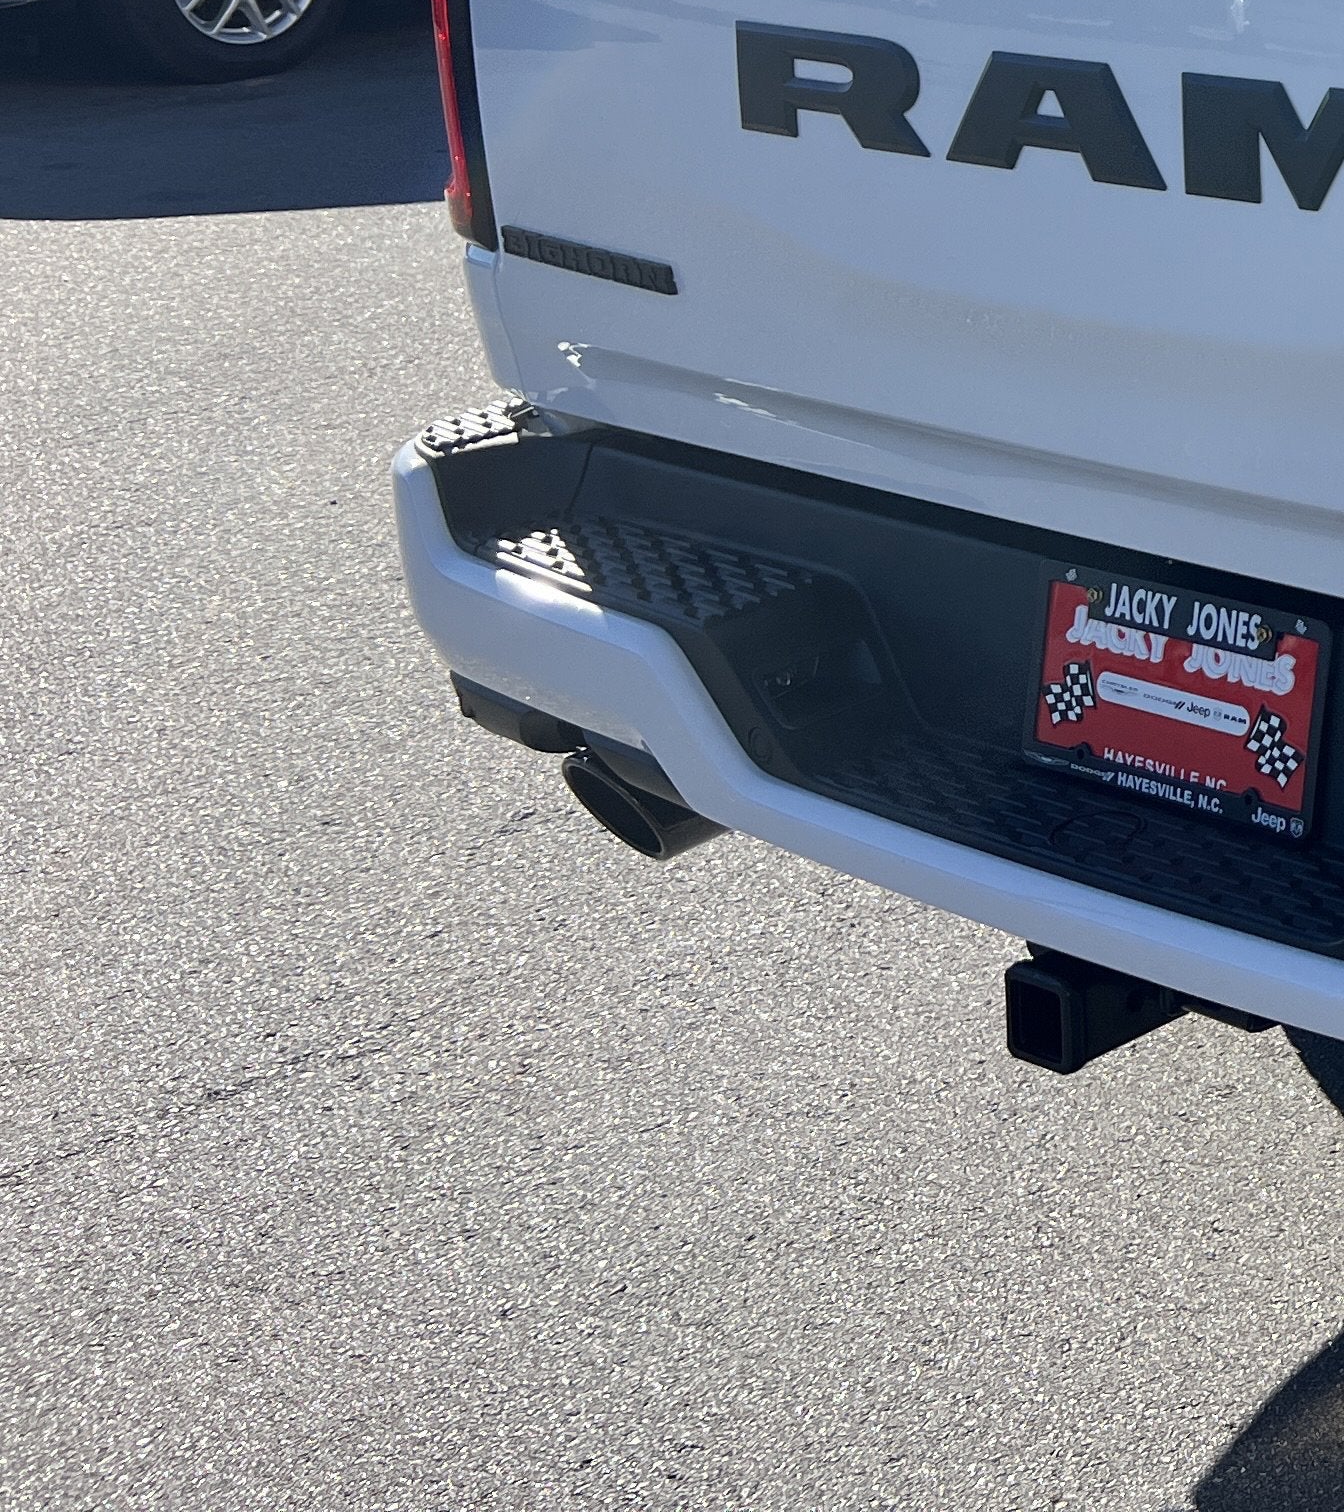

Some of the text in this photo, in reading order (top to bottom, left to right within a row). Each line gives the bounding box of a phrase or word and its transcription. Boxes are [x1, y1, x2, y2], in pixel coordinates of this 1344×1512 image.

[1104, 582, 1262, 650] JACKY JONES
[1186, 701, 1211, 719] Jeep
[1223, 713, 1247, 725] RAM
[1117, 771, 1224, 815] HAYESVILLE, N.C.
[1251, 806, 1287, 833] Jeep
